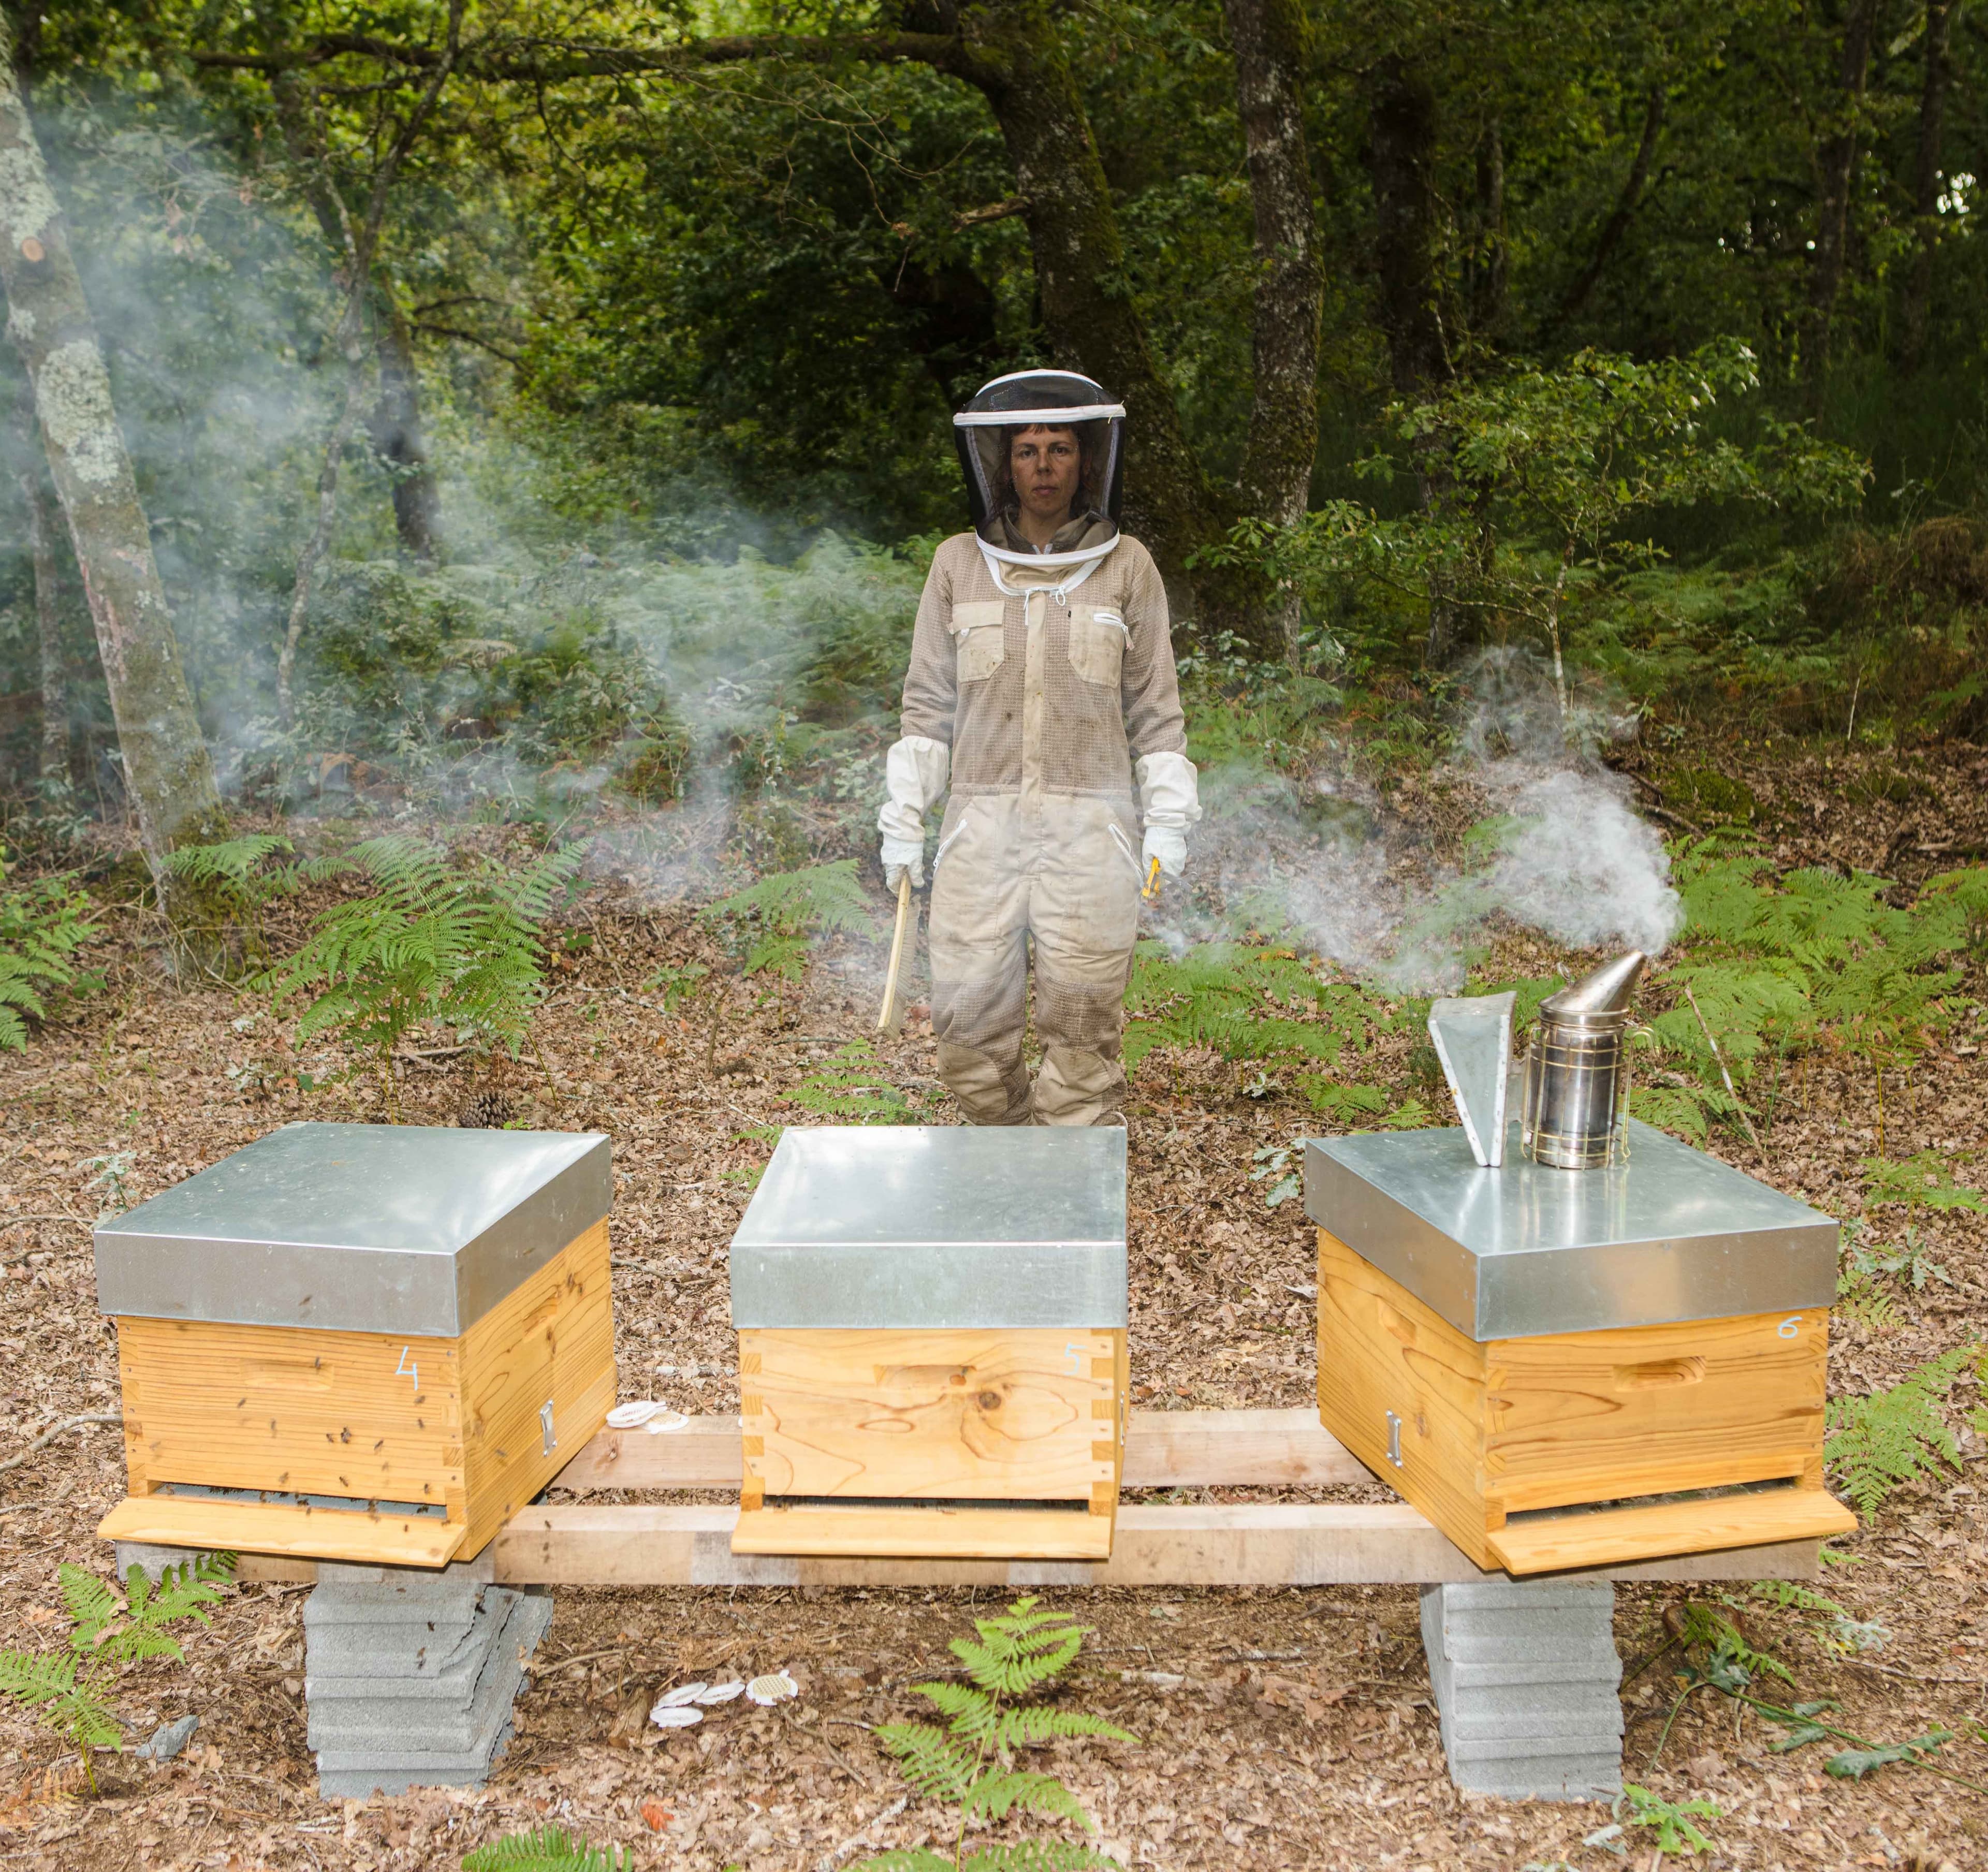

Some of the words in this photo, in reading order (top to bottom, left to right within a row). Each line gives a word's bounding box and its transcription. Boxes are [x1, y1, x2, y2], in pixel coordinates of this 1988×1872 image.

[1777, 1316, 1803, 1339] 6
[396, 1346, 418, 1391] 4
[1064, 1342, 1088, 1376] 5
